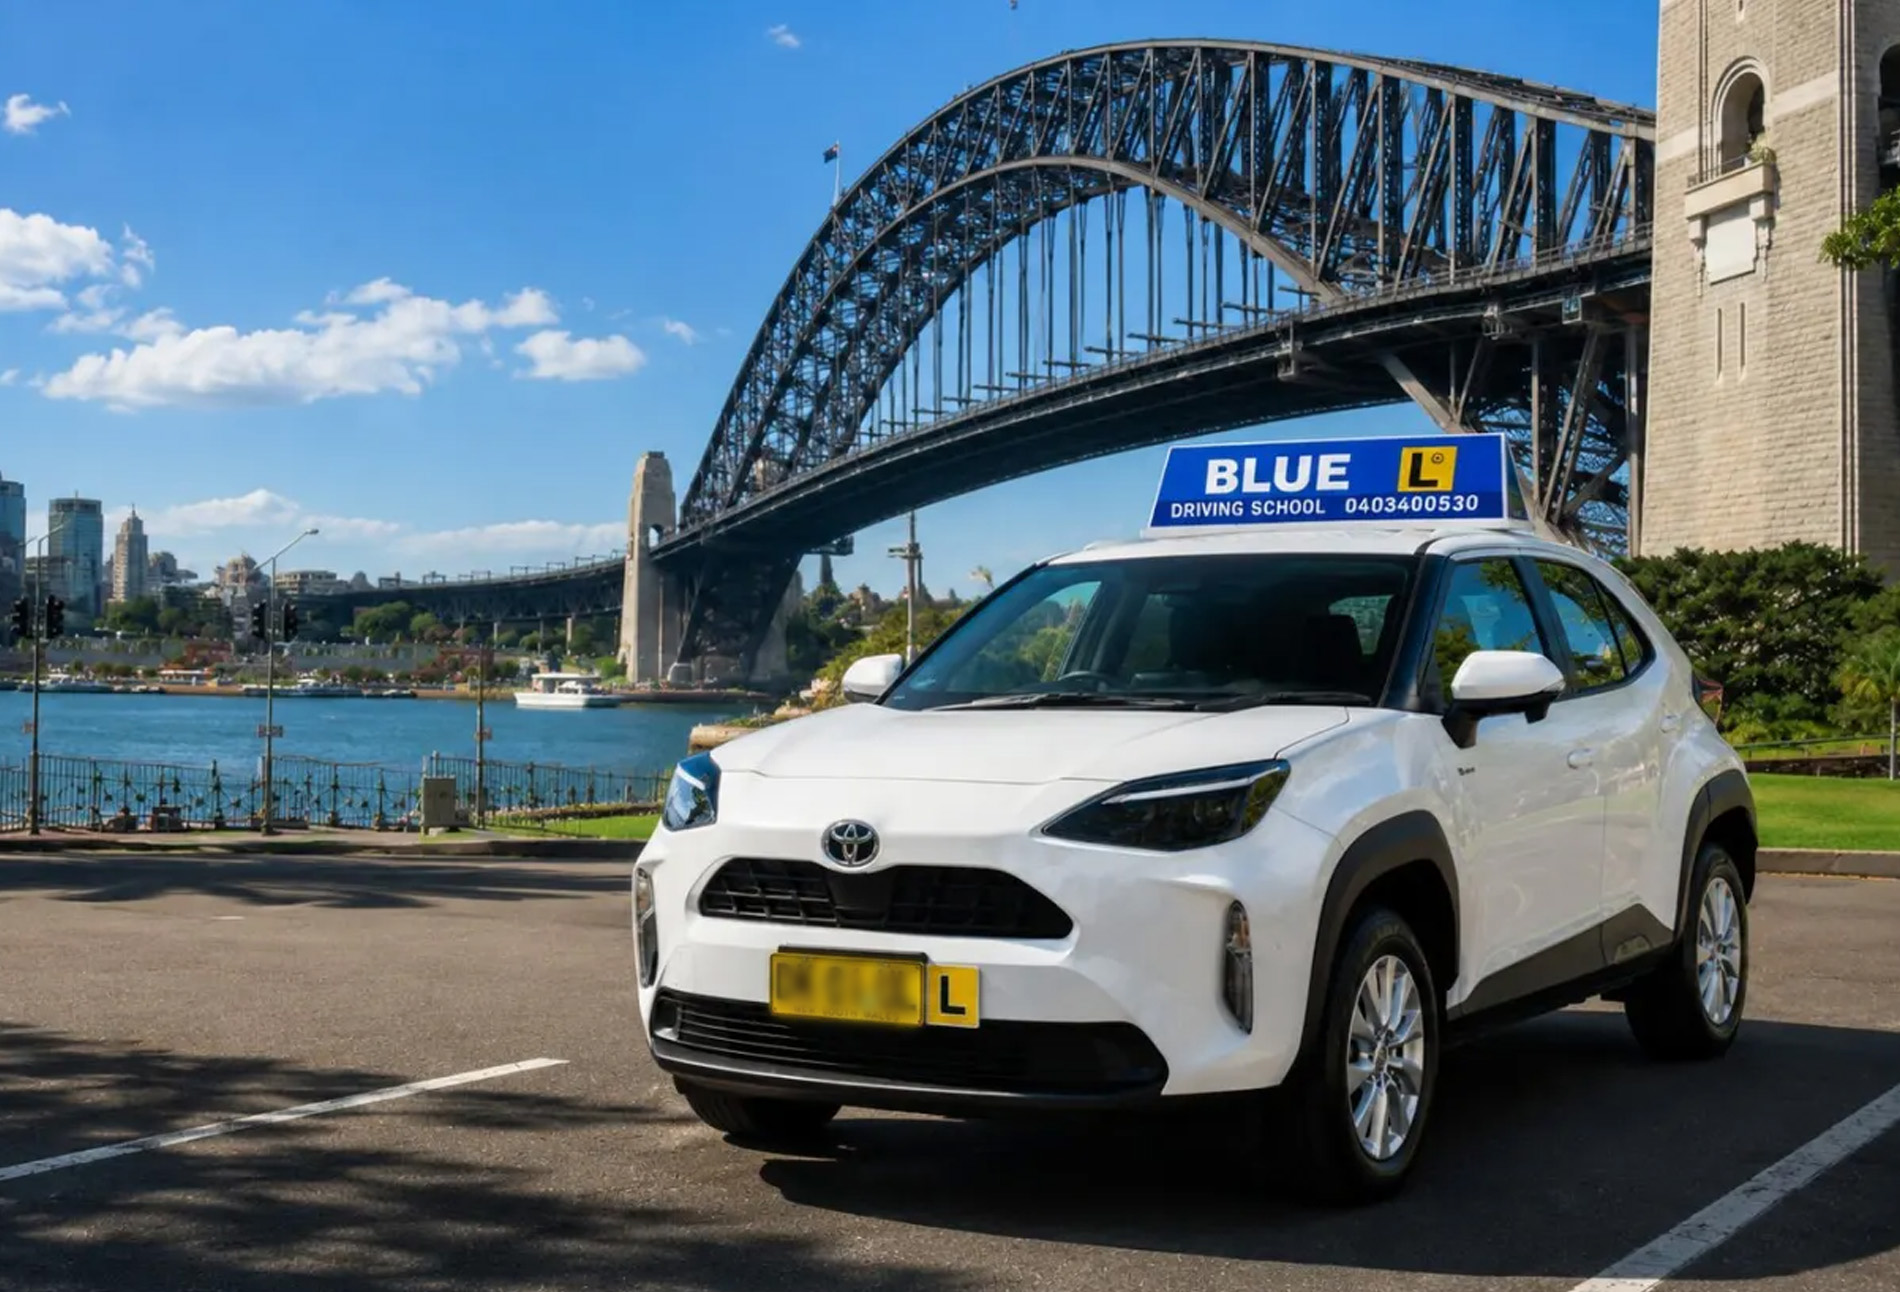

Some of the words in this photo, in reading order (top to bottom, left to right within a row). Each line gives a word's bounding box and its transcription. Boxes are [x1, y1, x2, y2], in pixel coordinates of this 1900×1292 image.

[1205, 453, 1351, 495] BLUE
[1408, 453, 1438, 488] L
[1171, 501, 1244, 518] DRIVING
[1251, 499, 1326, 515] SCHOOL
[1345, 495, 1479, 514] 0403400530
[940, 975, 966, 1015] L
